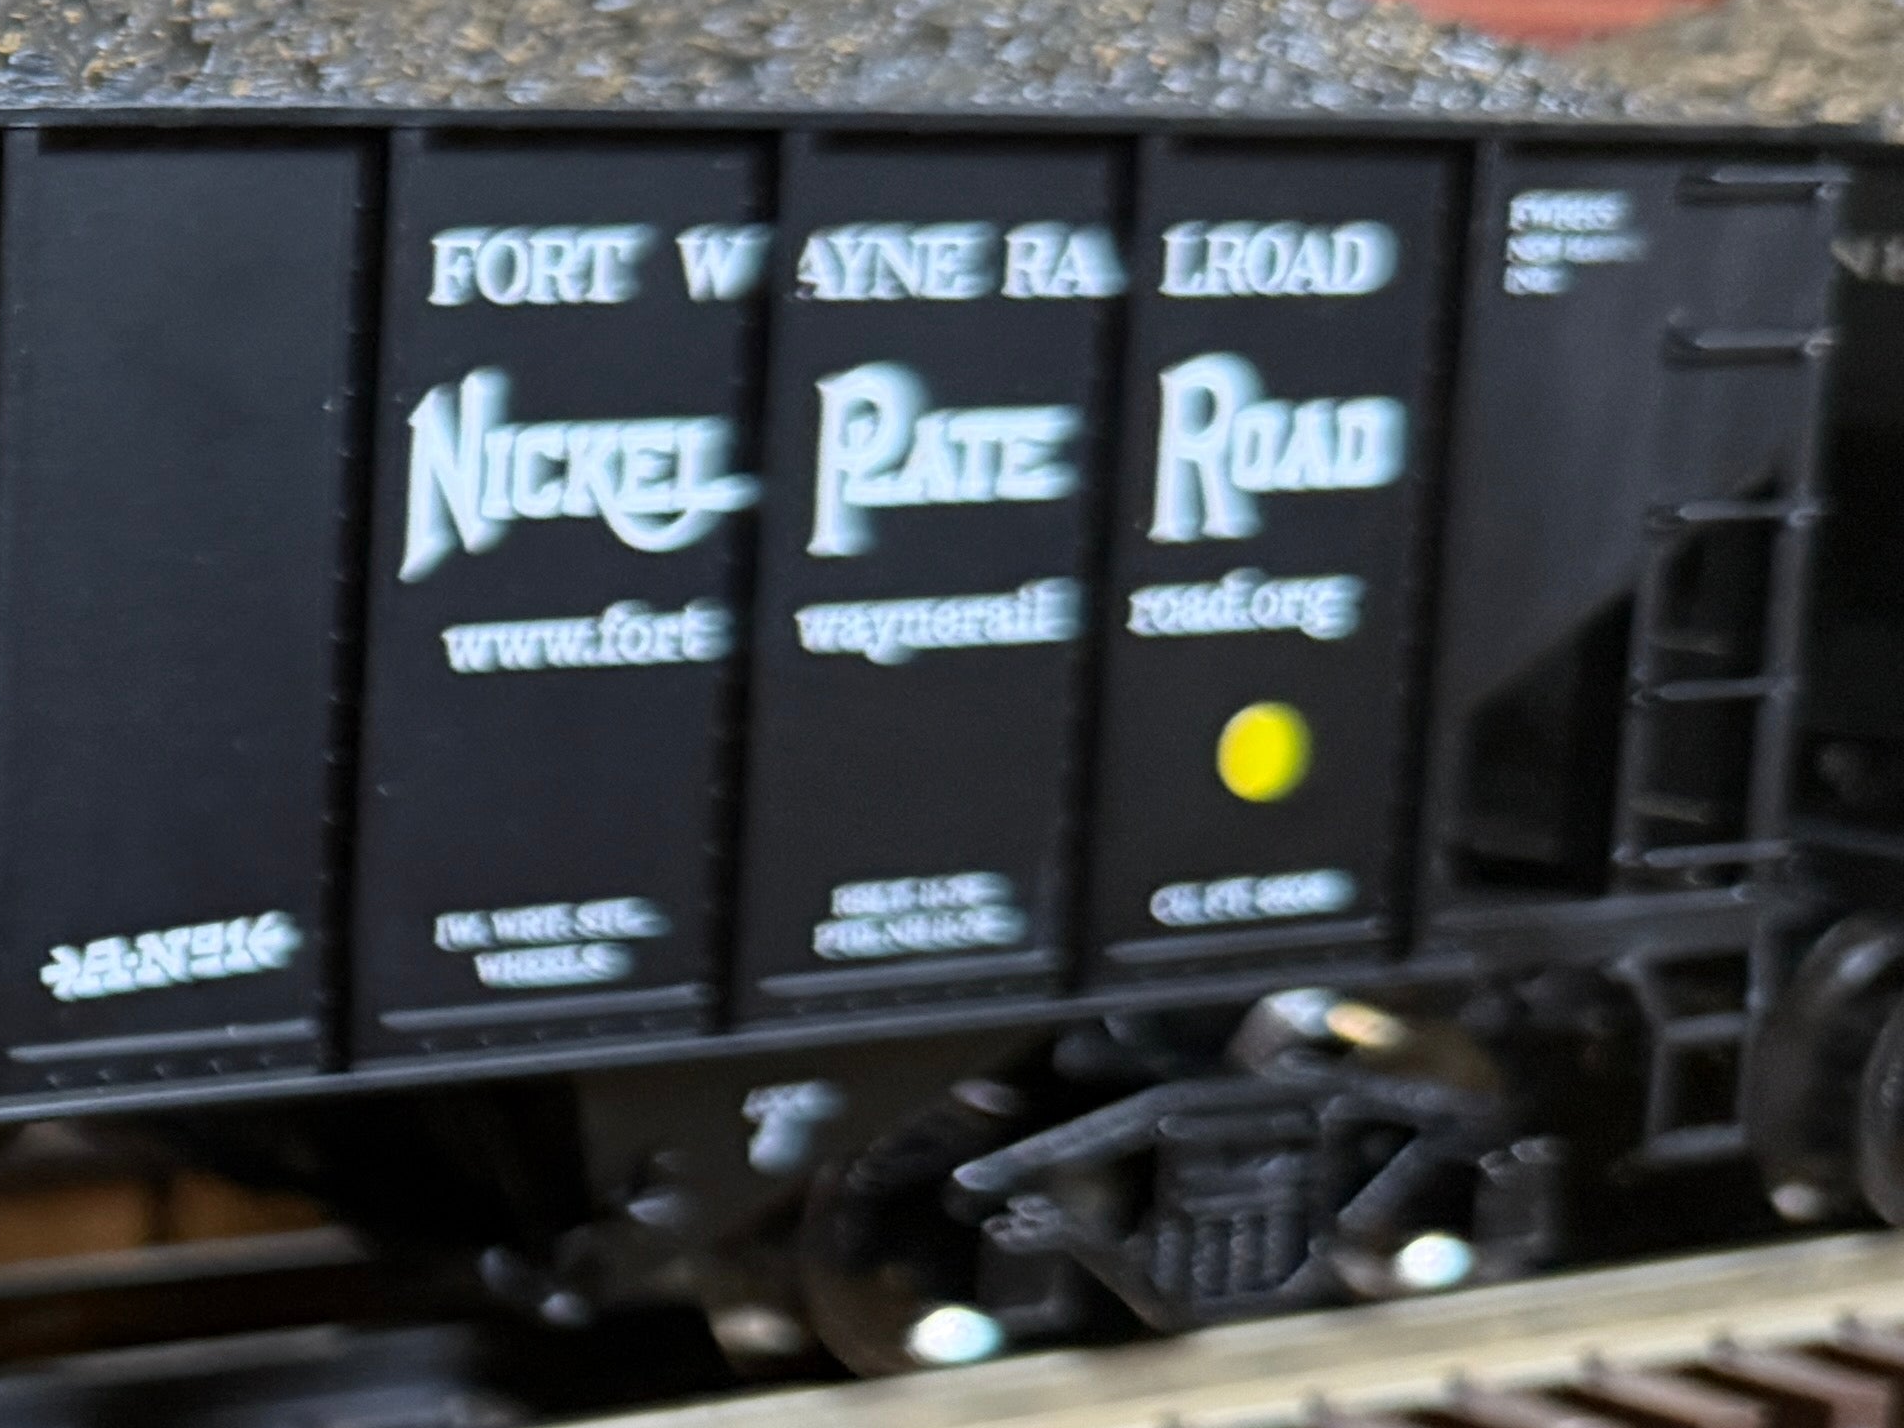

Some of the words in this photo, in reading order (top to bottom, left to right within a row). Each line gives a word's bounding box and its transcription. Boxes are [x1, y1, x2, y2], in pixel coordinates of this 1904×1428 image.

[427, 223, 658, 306] FORT
[397, 368, 764, 582] NICKEL
[1146, 352, 1407, 543] ROAD
[441, 597, 738, 675] www.fort
[1125, 568, 1366, 641] road.org
